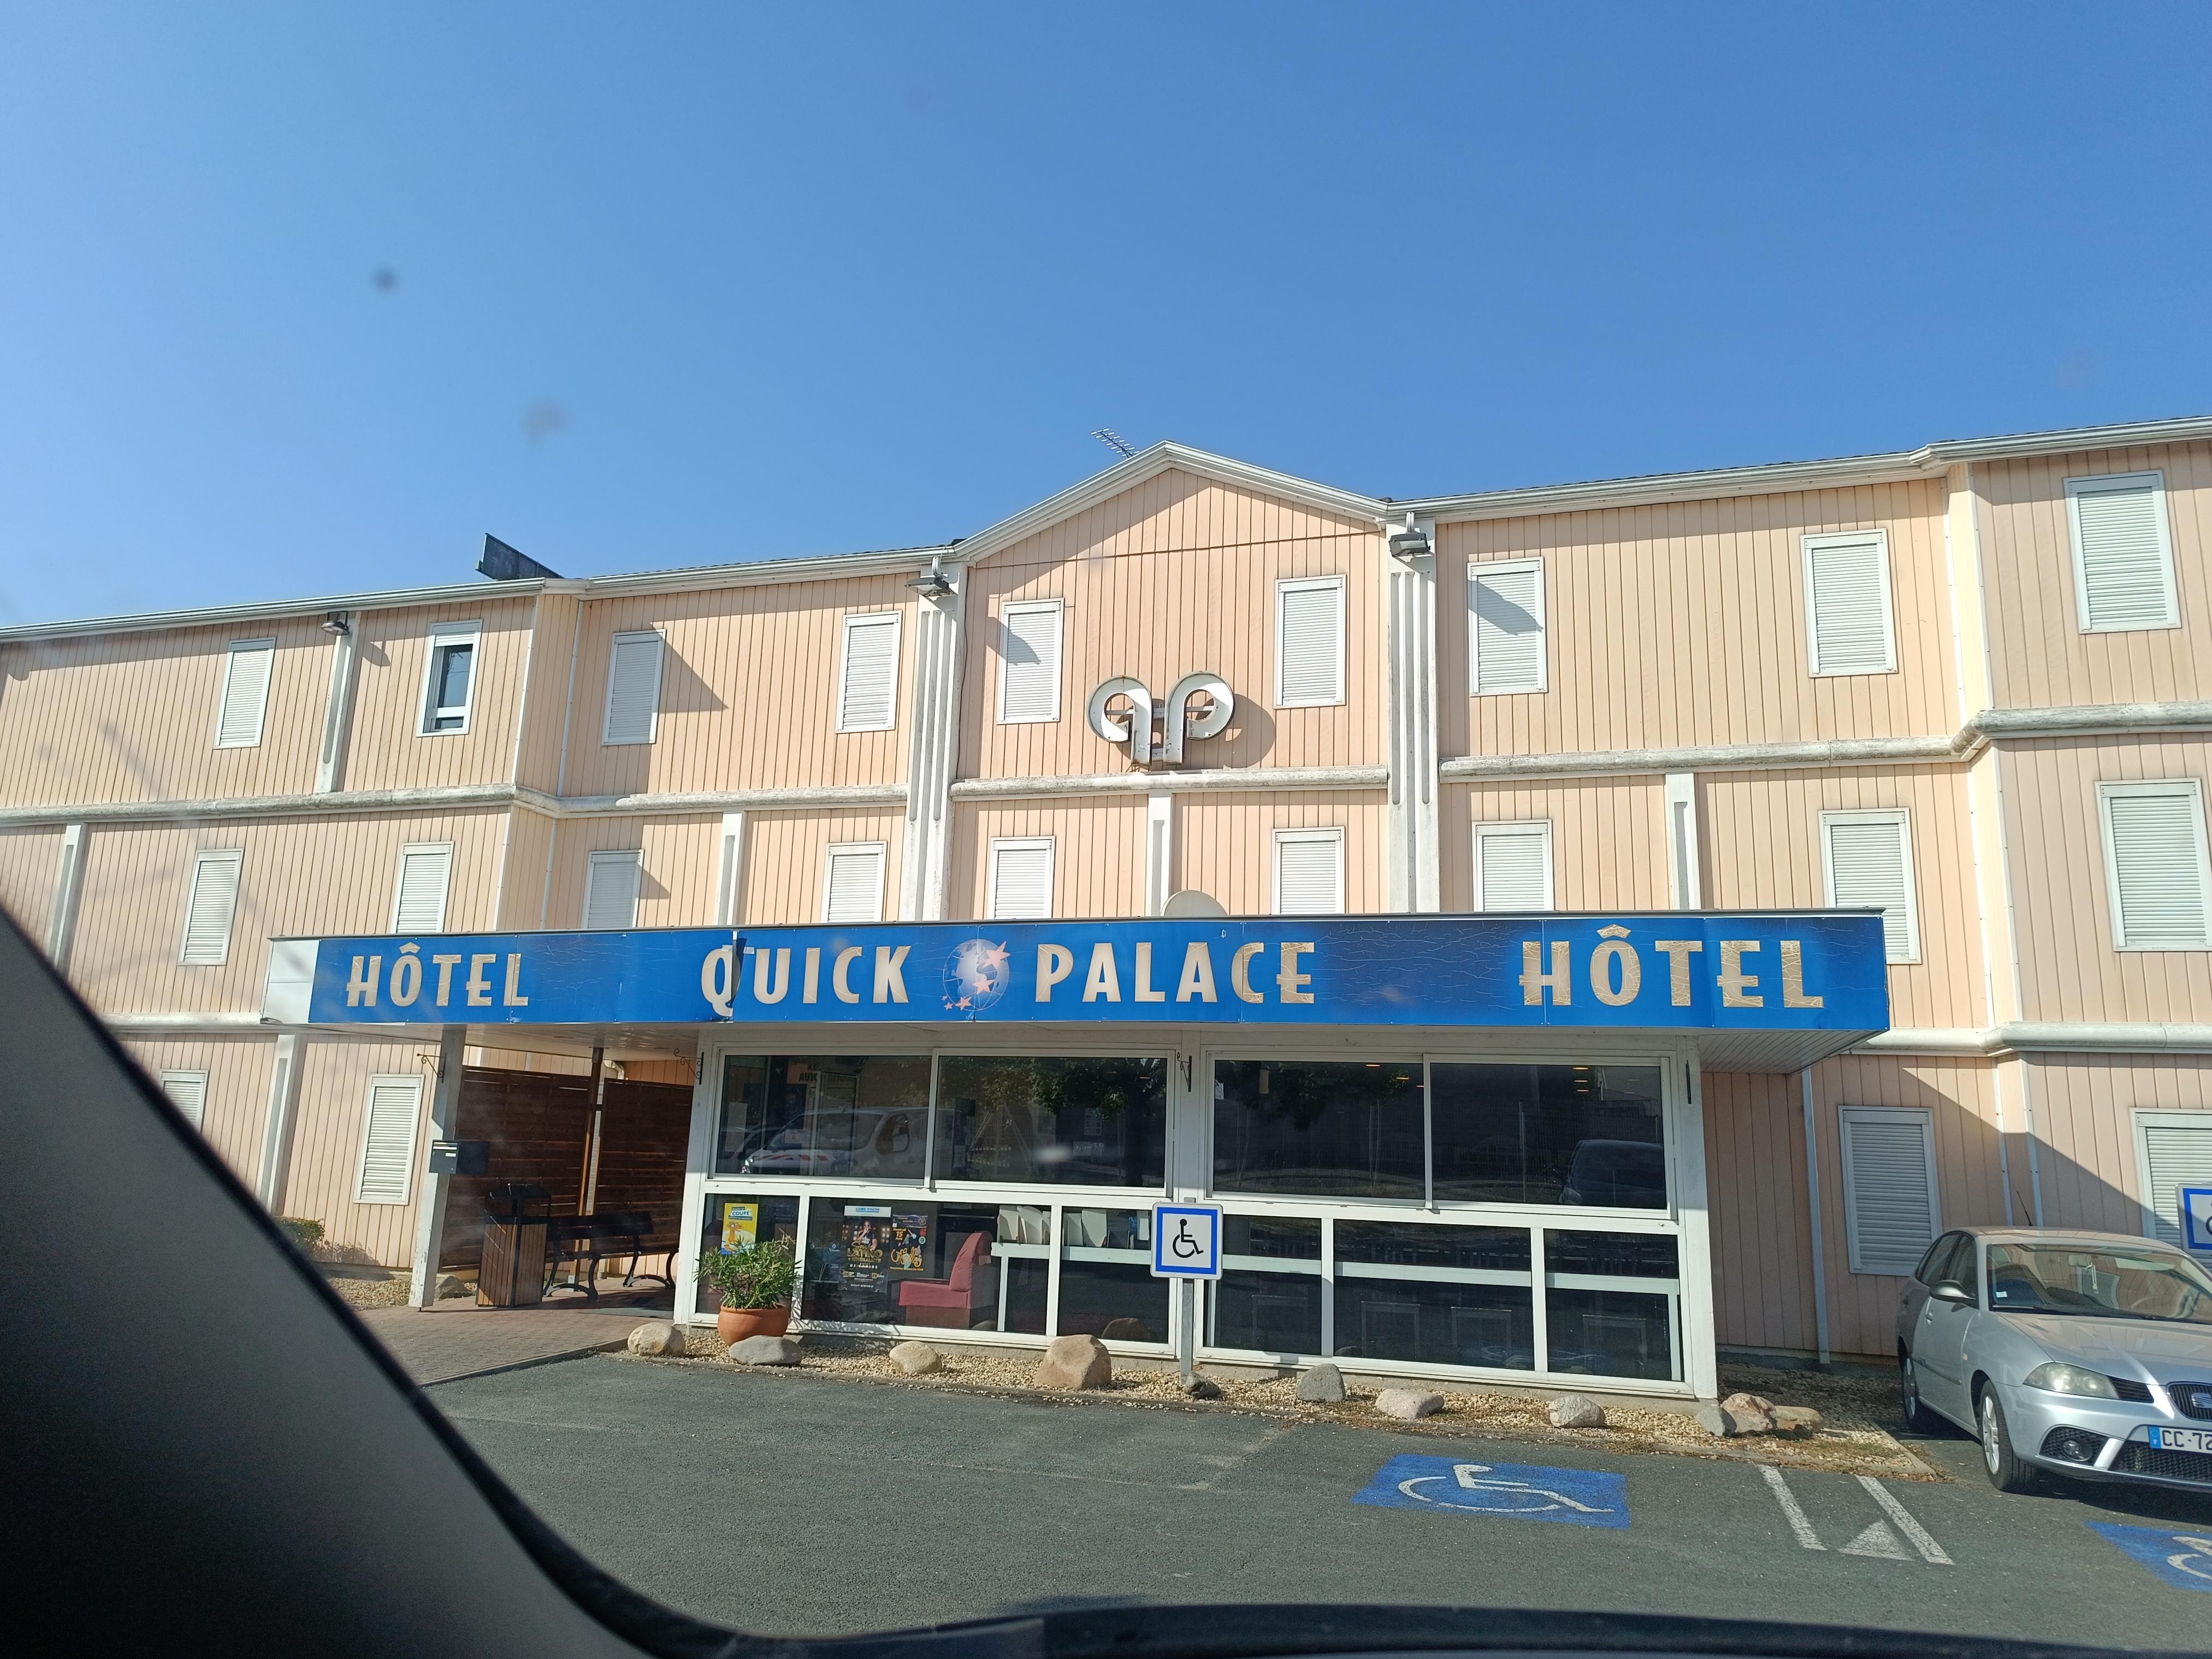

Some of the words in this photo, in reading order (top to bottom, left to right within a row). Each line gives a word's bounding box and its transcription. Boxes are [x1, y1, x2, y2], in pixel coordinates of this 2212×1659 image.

[346, 942, 529, 1007] HÔTEL
[701, 946, 912, 1017] QUICK
[1035, 941, 1315, 1004] PALACE
[1519, 923, 1824, 1008] HÔTEL
[847, 1248, 883, 1258] LATINO
